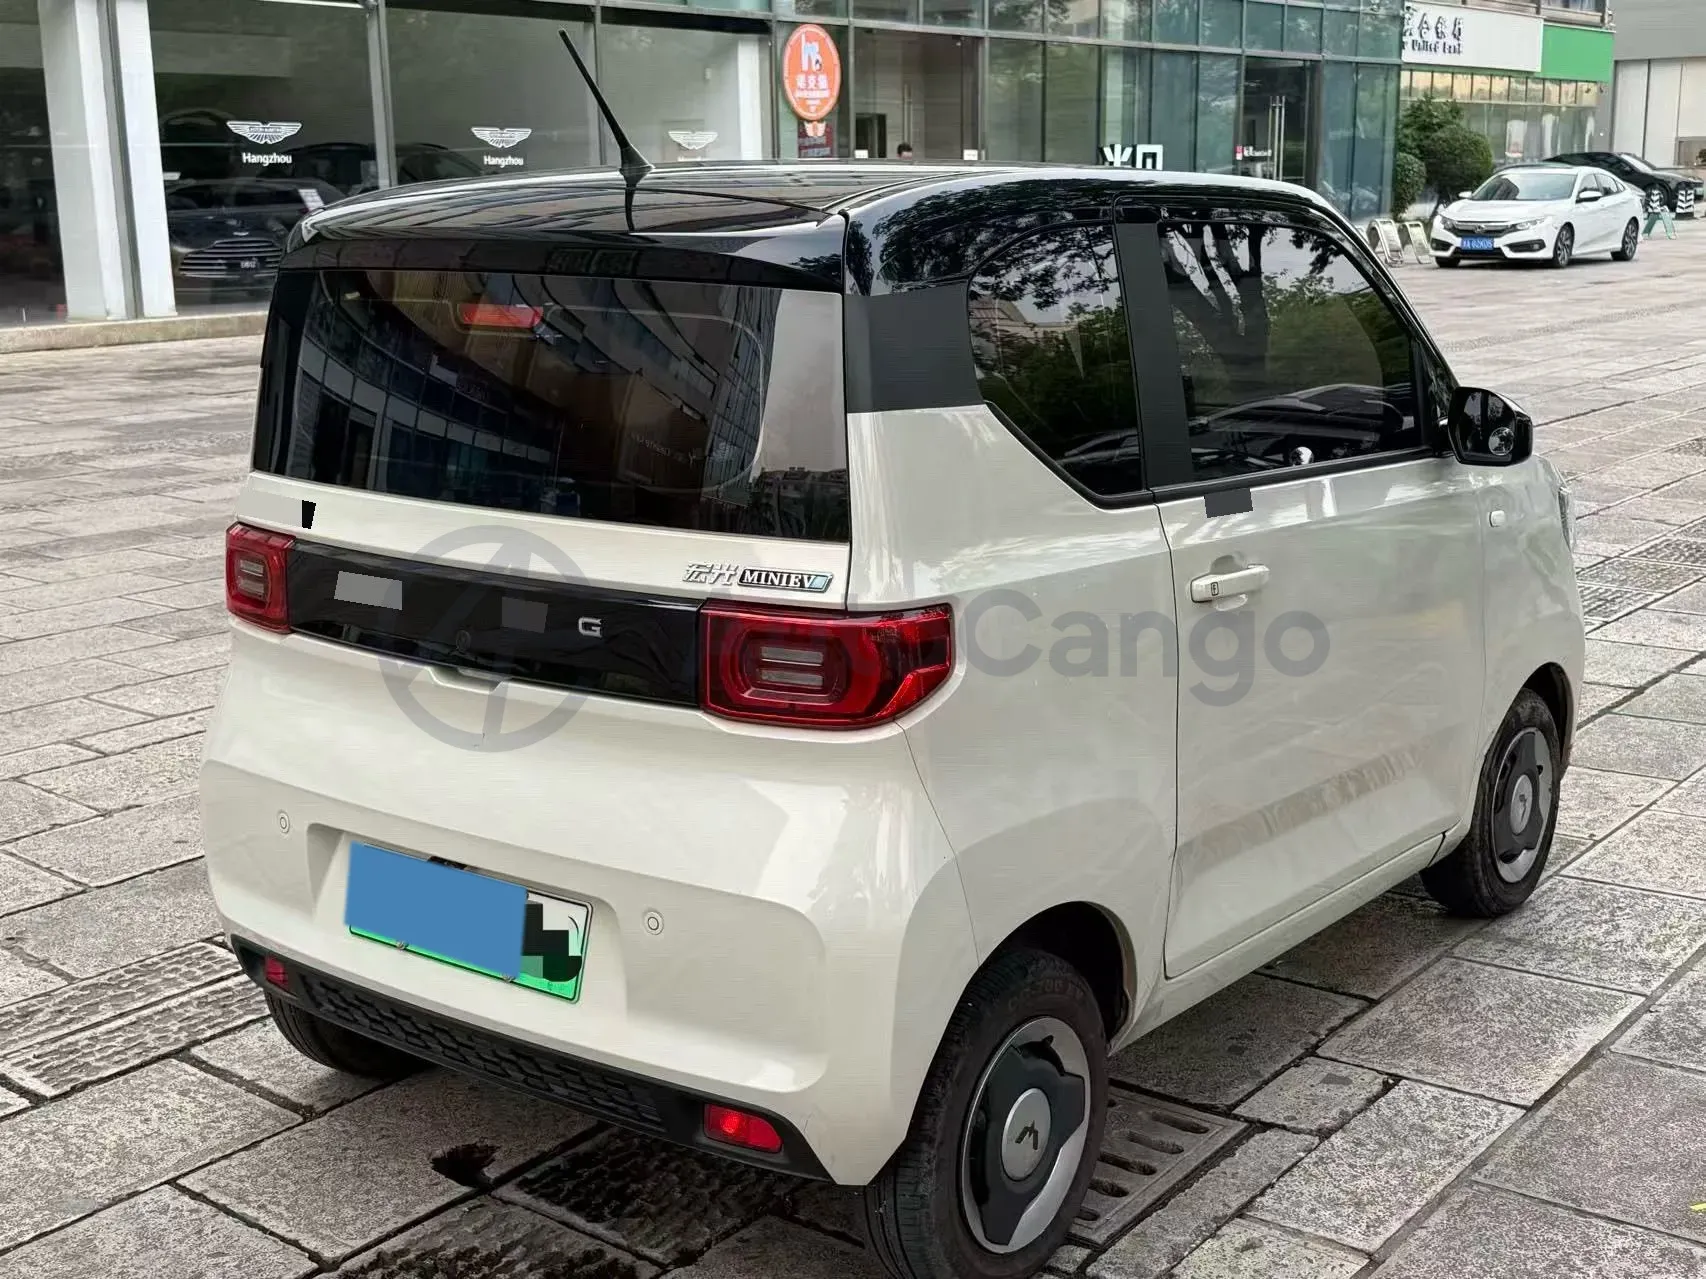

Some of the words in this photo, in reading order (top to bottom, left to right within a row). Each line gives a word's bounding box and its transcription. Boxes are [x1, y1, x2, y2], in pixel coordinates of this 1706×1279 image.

[242, 152, 292, 167] Hangzhou
[483, 155, 524, 168] Hangzhou
[682, 562, 739, 586] 宏光
[743, 569, 817, 589] MINIEV
